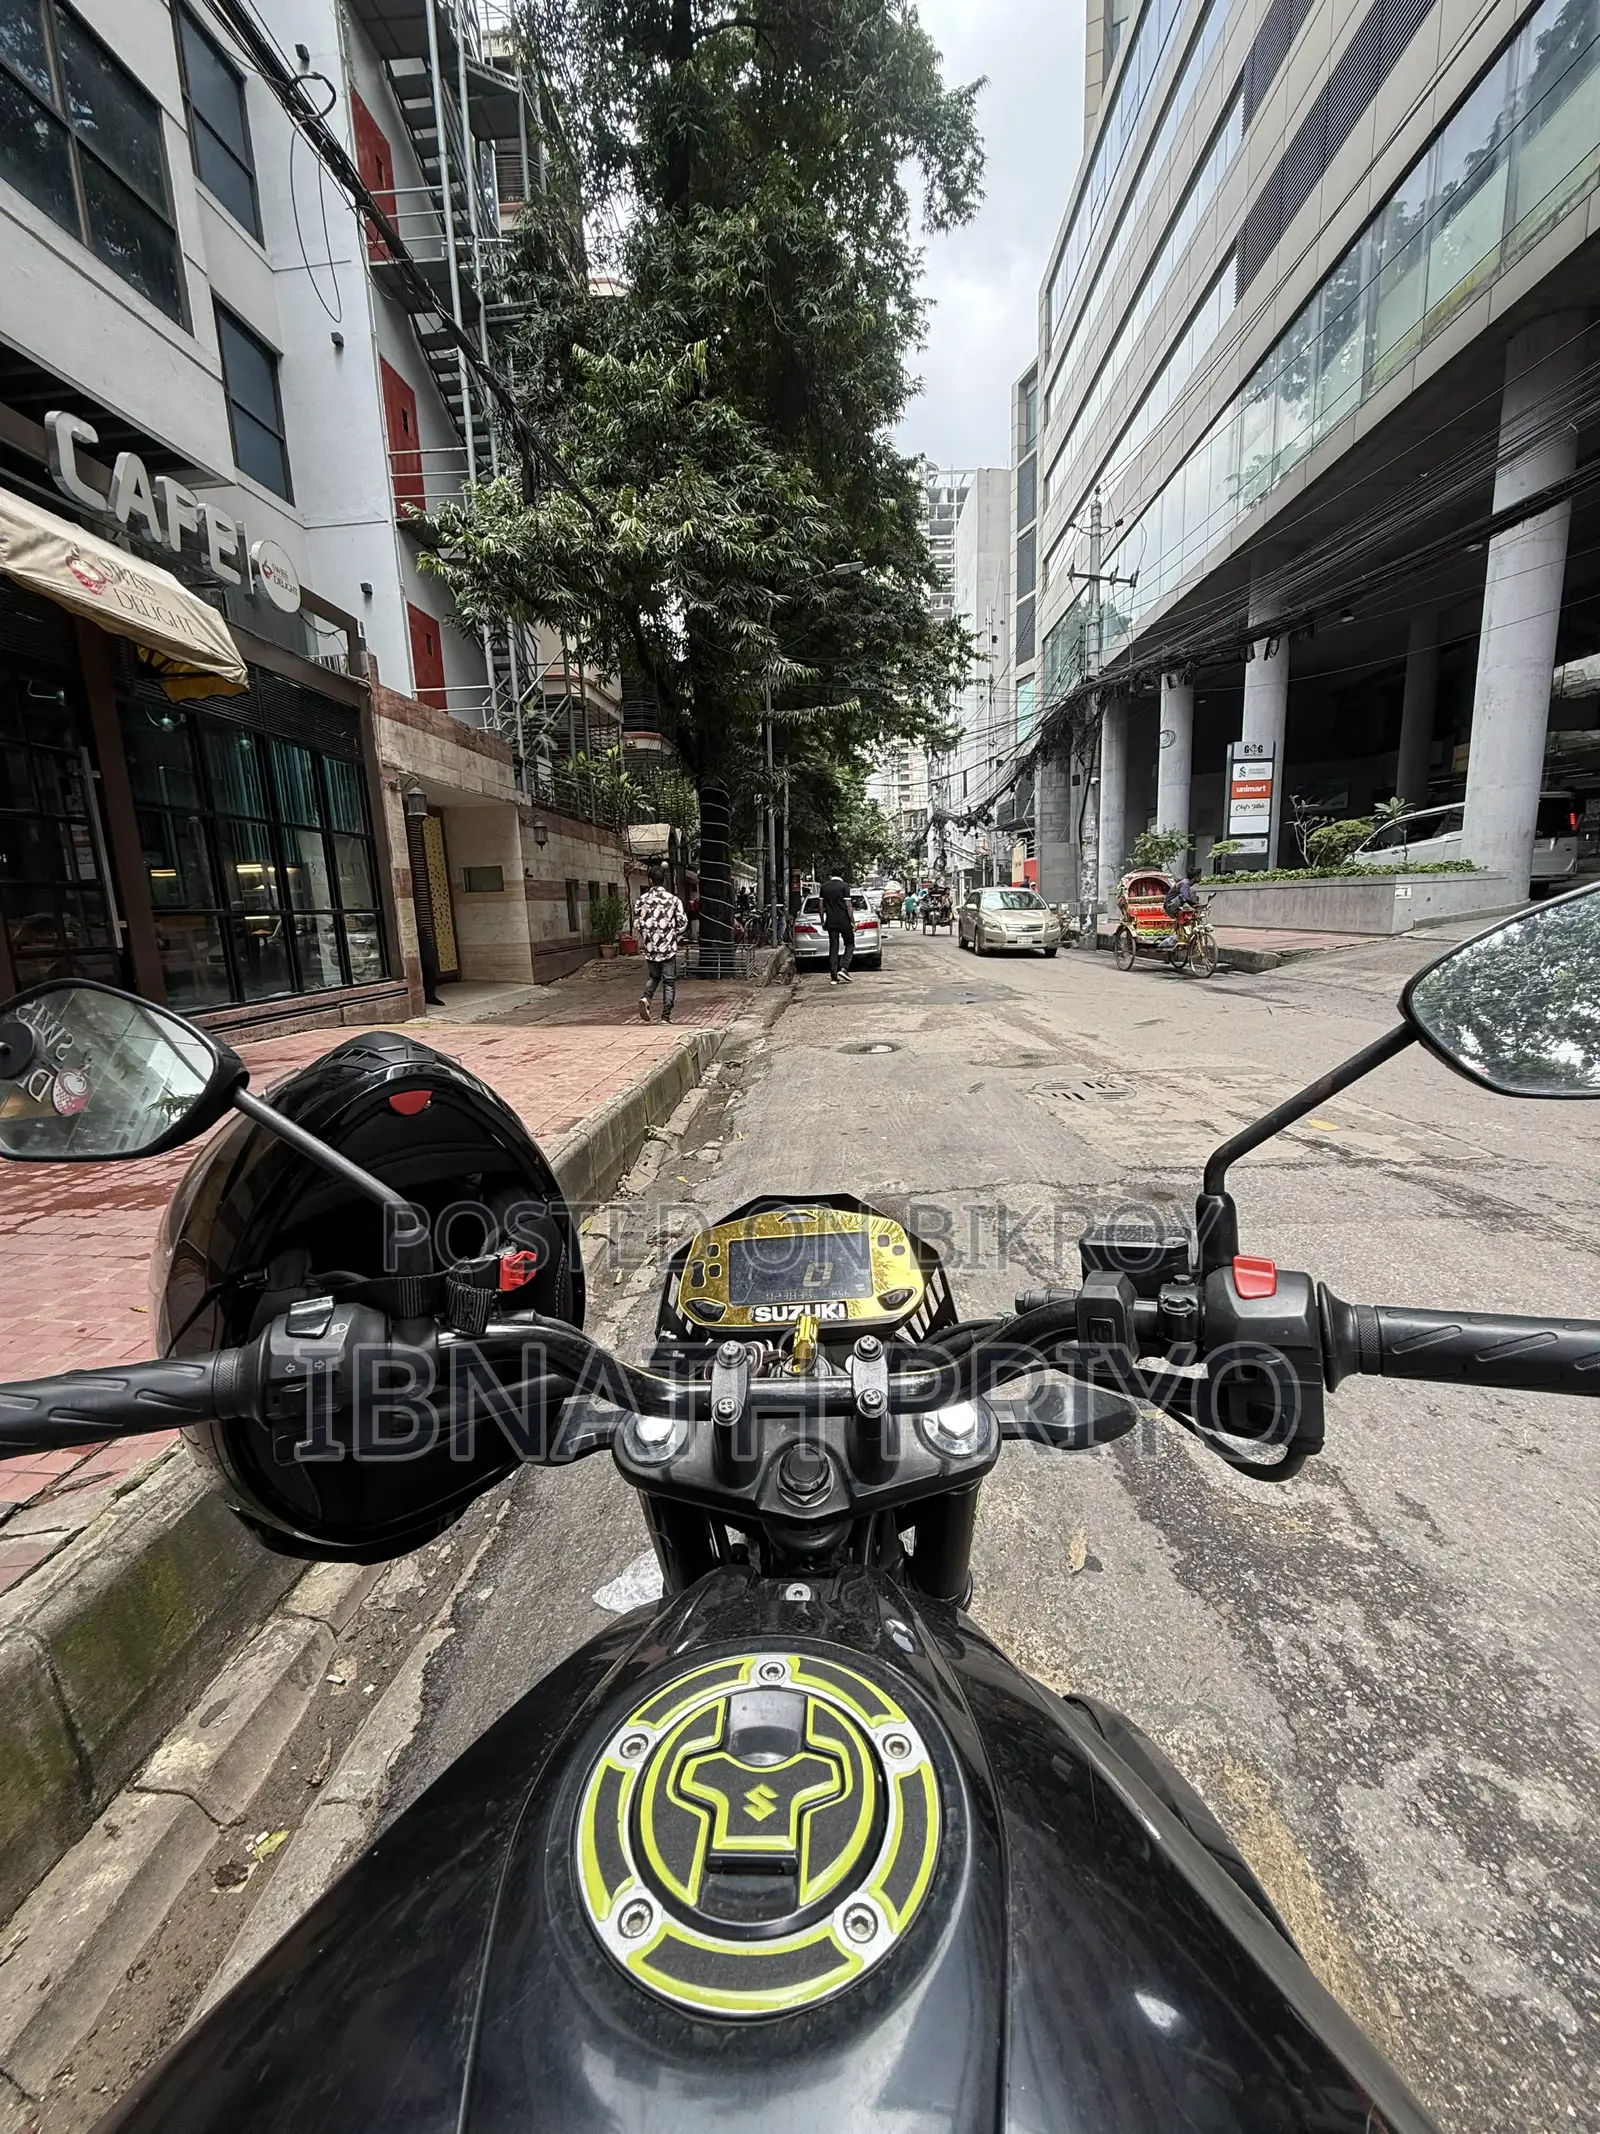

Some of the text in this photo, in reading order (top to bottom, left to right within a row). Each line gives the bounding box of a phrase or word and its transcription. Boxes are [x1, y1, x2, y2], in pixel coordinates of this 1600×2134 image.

[45, 411, 241, 585] CAFE
[98, 557, 156, 596] SWISS
[113, 588, 194, 635] DELIGHT
[1236, 785, 1266, 793] unimart
[755, 1303, 845, 1322] SUZUKI
